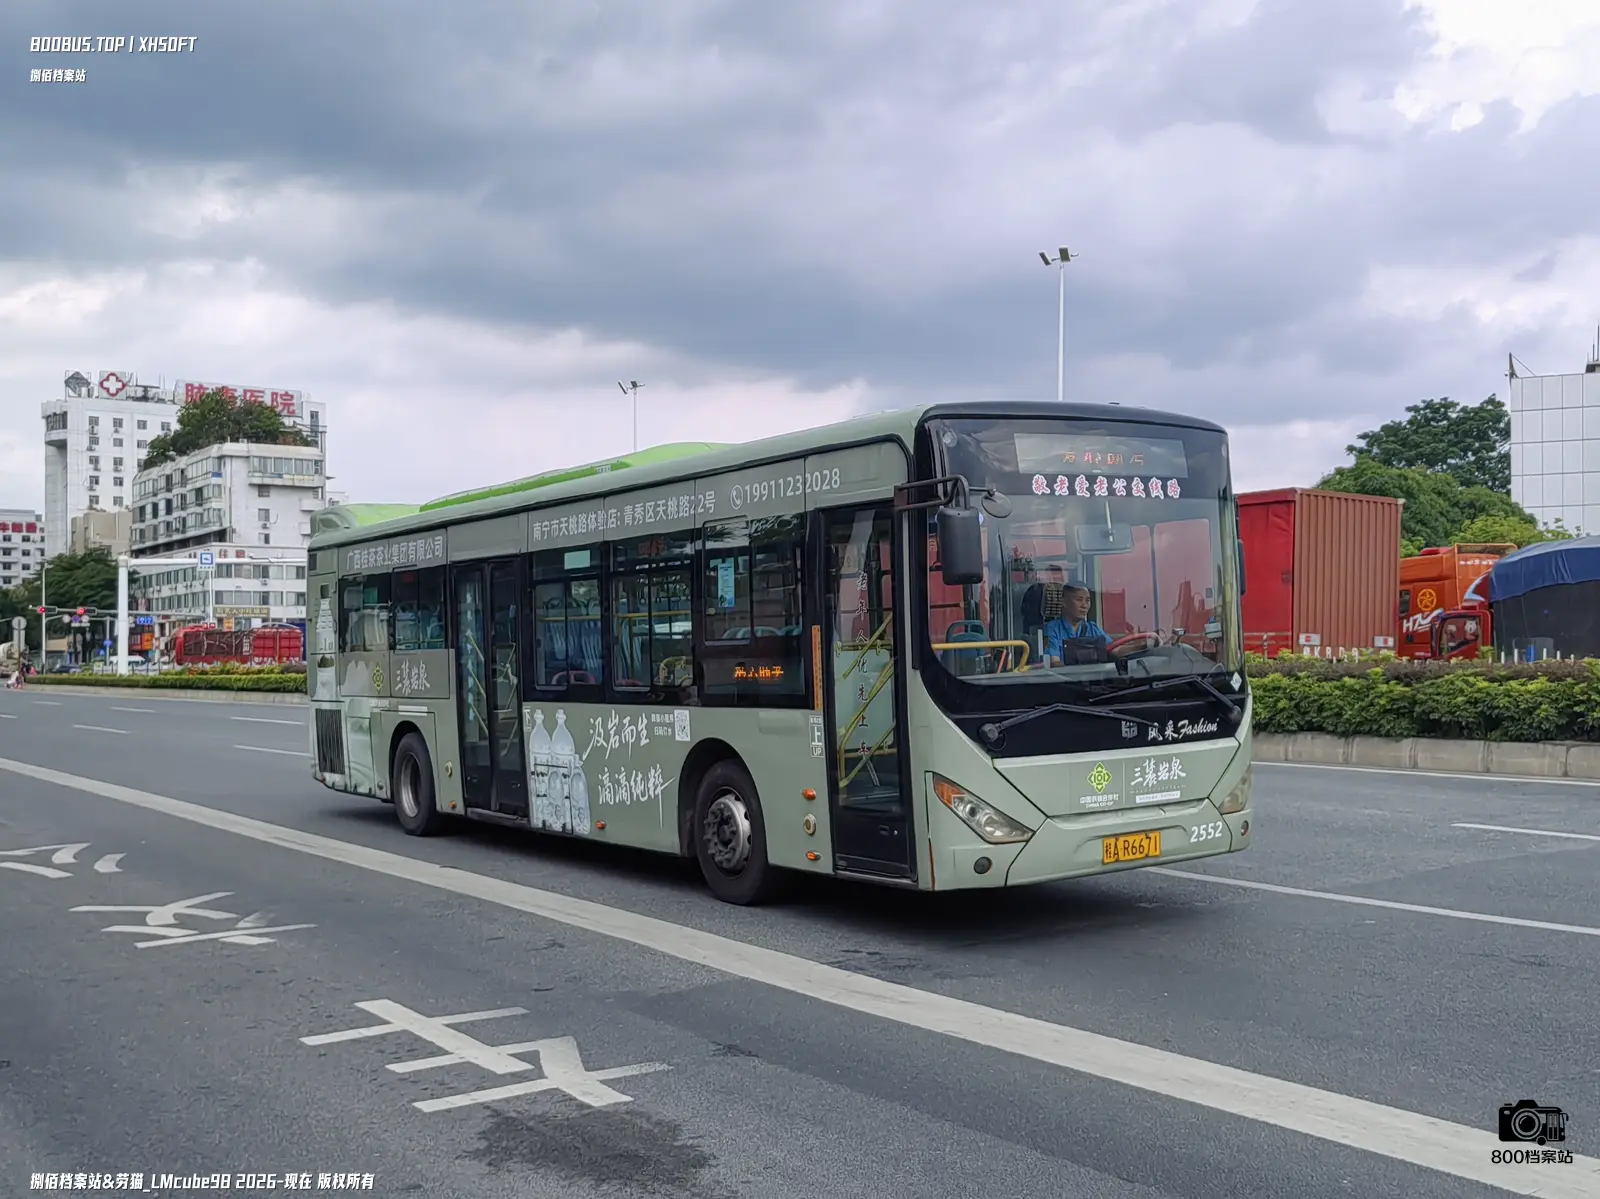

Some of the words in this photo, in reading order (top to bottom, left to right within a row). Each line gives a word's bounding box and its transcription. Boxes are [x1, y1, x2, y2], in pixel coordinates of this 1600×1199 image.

[744, 467, 840, 503] 19911232028
[1032, 474, 1181, 499] 敬老爱老公交线路
[582, 708, 650, 761] 汲岩而生
[811, 726, 822, 745] 上
[813, 747, 822, 756] UP
[598, 763, 676, 830] 滴滴纯粹
[1190, 821, 1223, 844] 2552
